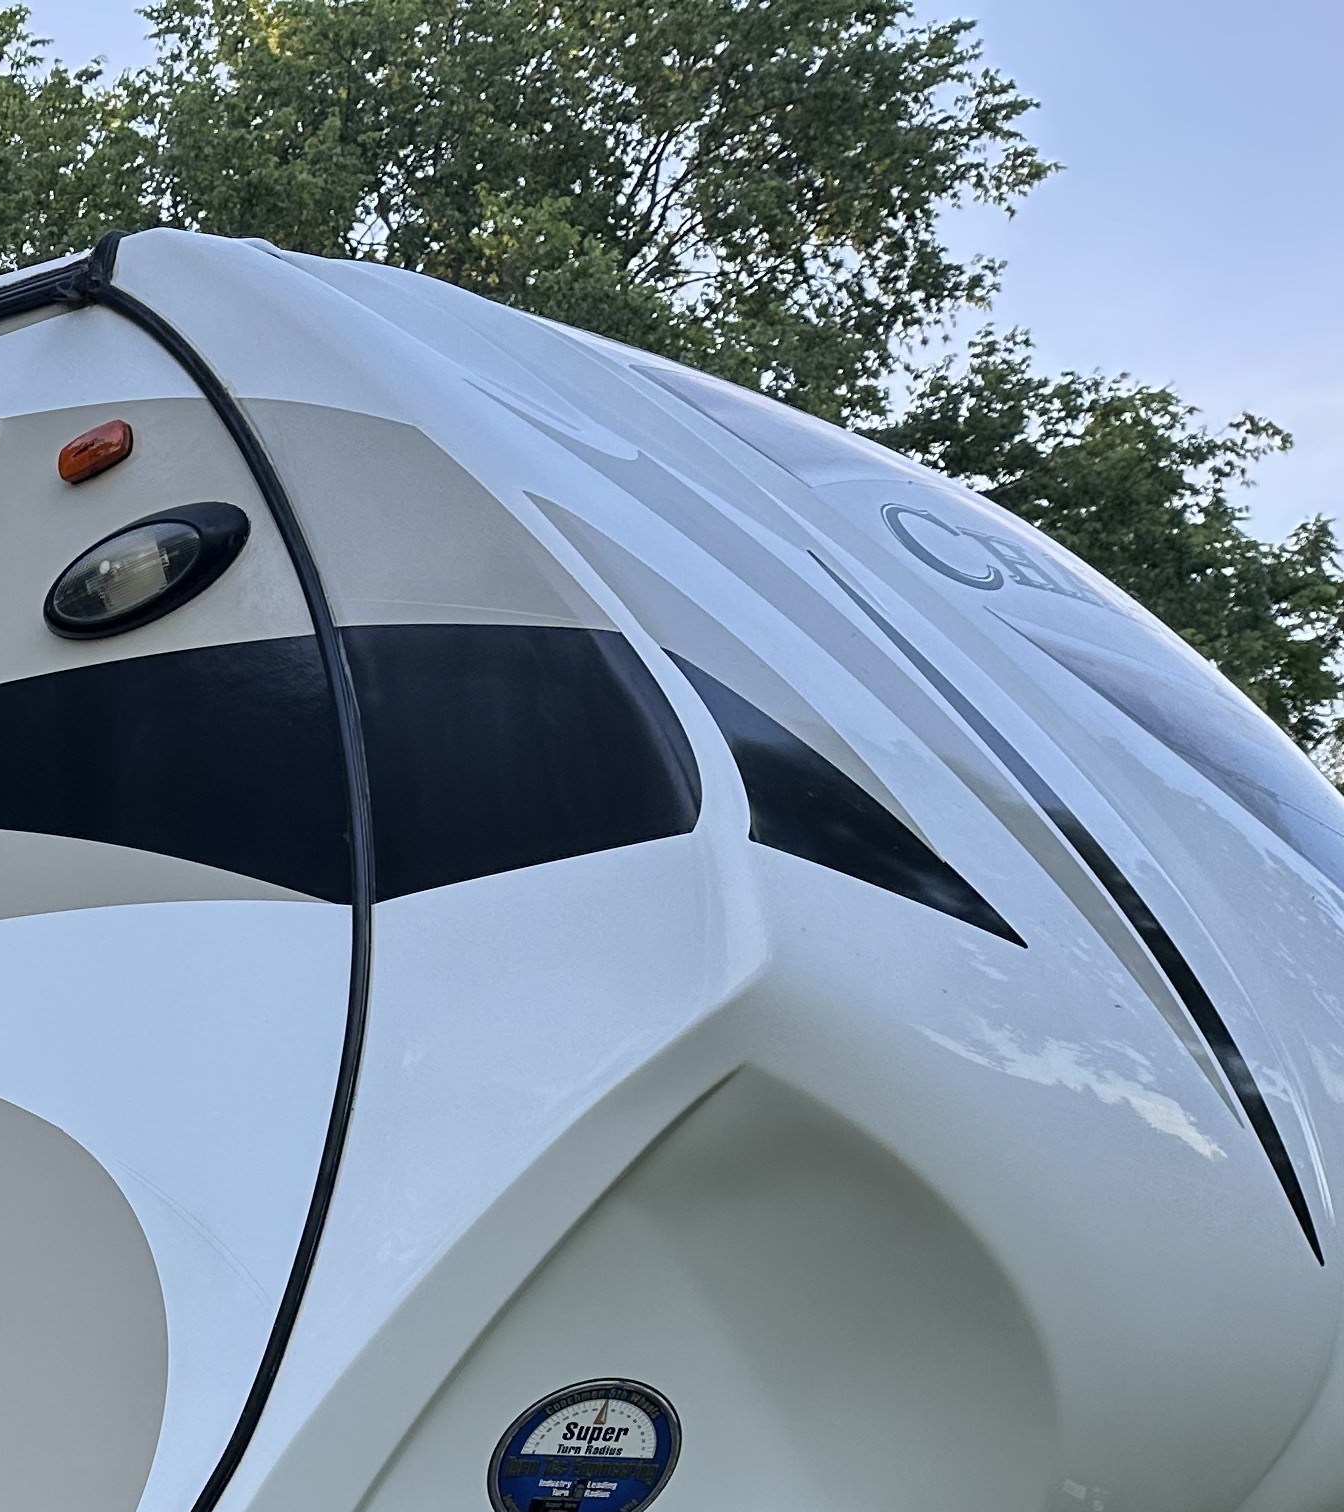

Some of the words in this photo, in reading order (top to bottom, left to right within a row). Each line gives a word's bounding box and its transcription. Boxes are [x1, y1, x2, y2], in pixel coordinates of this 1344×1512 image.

[545, 1389, 606, 1415] Coachmen
[608, 1387, 629, 1400] 5th
[630, 1391, 662, 1420] Wheels
[561, 1421, 630, 1445] Super
[556, 1443, 582, 1455] Turn
[584, 1444, 624, 1456] Radius
[538, 1478, 573, 1489] Industry
[586, 1480, 618, 1491] Leading
[583, 1489, 611, 1498] Radius
